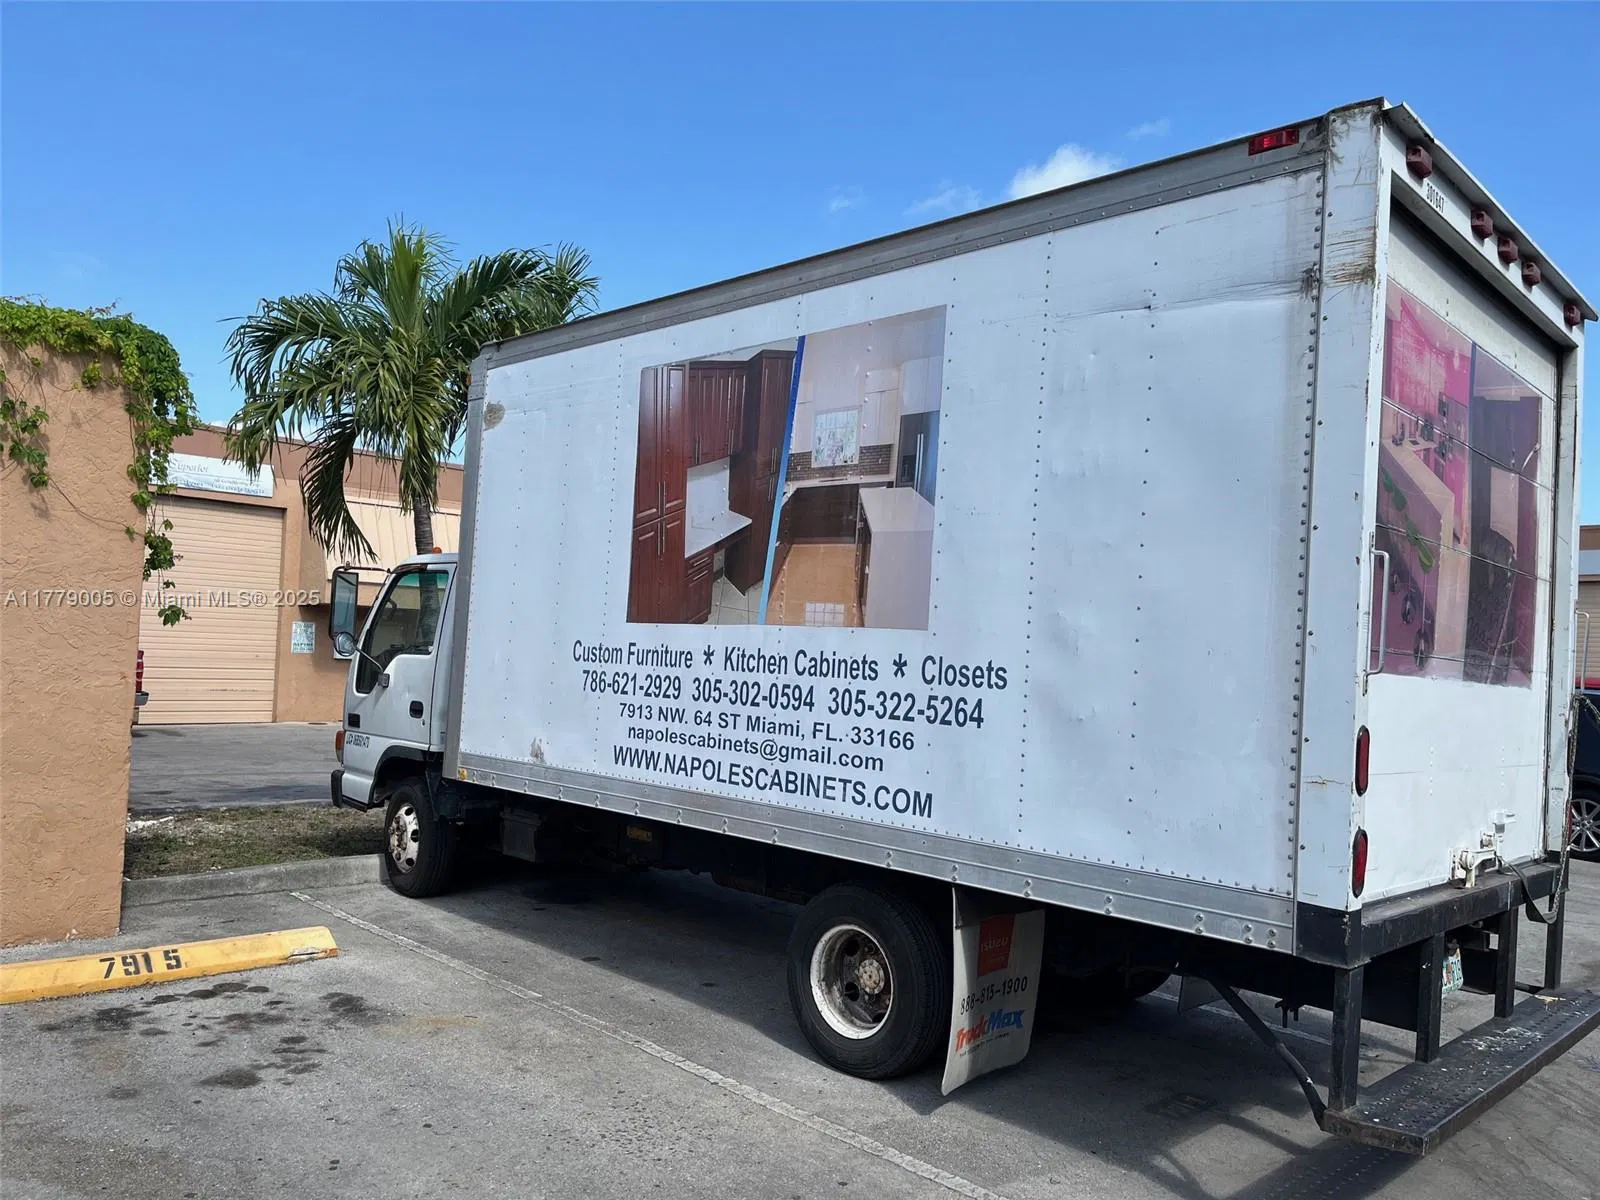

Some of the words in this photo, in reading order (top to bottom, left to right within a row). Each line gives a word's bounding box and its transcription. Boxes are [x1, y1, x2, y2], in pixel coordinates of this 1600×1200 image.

[573, 639, 623, 665] Custom
[627, 642, 694, 669] Furniture
[724, 646, 788, 675] Kitchen
[794, 649, 879, 681] Cabinets
[921, 655, 1008, 690] Closets
[582, 669, 682, 700] 786-621-2929
[691, 677, 815, 712] 305-302-0594
[828, 686, 984, 729] 305-322-5264
[619, 702, 653, 720] 7913
[658, 705, 689, 725] NW.
[694, 710, 713, 727] 64
[718, 712, 741, 730] ST
[746, 715, 805, 740] Miami,
[812, 721, 843, 742] FL.
[850, 726, 915, 750] 33166
[628, 726, 884, 772] napolescabinets@gmail.com
[613, 745, 933, 819] WWW.NAPOLESCABINETS.COM
